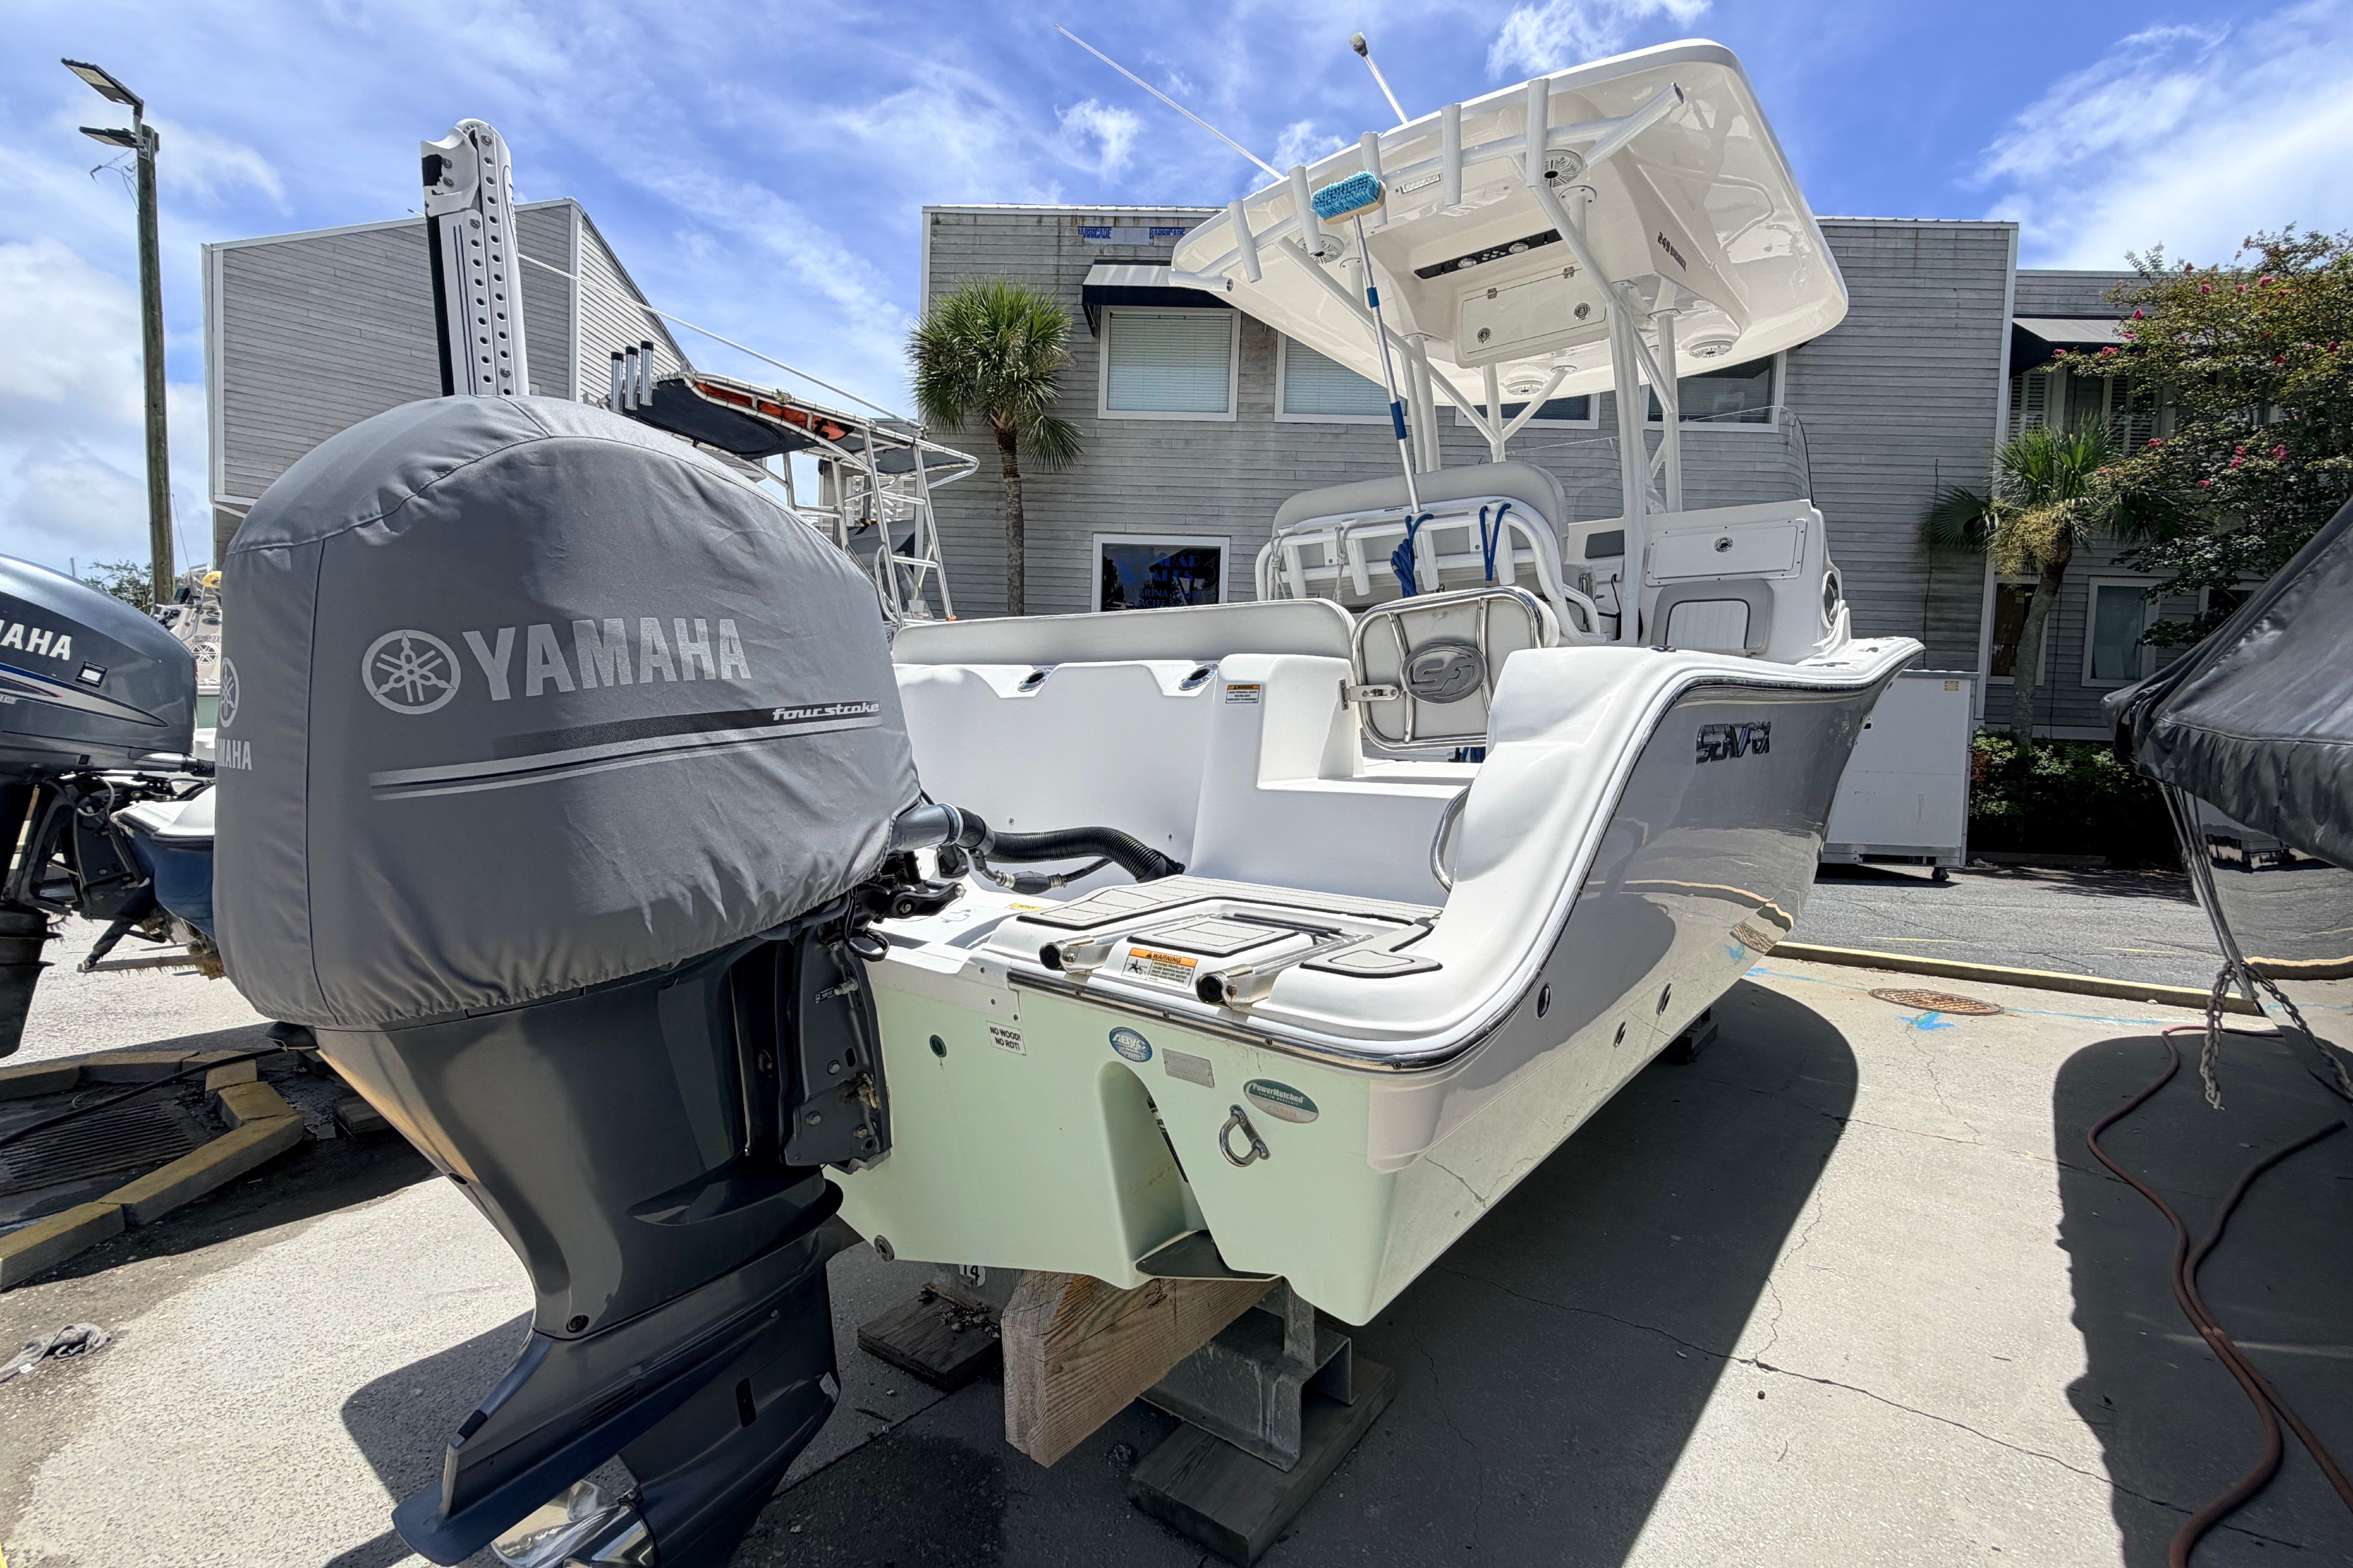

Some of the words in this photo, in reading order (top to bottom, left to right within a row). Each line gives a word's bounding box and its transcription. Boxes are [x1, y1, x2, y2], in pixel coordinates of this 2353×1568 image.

[1657, 231, 1670, 253] 249
[192, 635, 221, 643] 220
[462, 617, 752, 700] YAMAHA
[215, 739, 252, 771] MAHA
[1153, 953, 1182, 963] WARNING
[990, 1026, 999, 1035] NO
[995, 1036, 1004, 1046] NO
[1112, 1034, 1146, 1050] ABYC
[1252, 1082, 1304, 1104] PowerMatched
